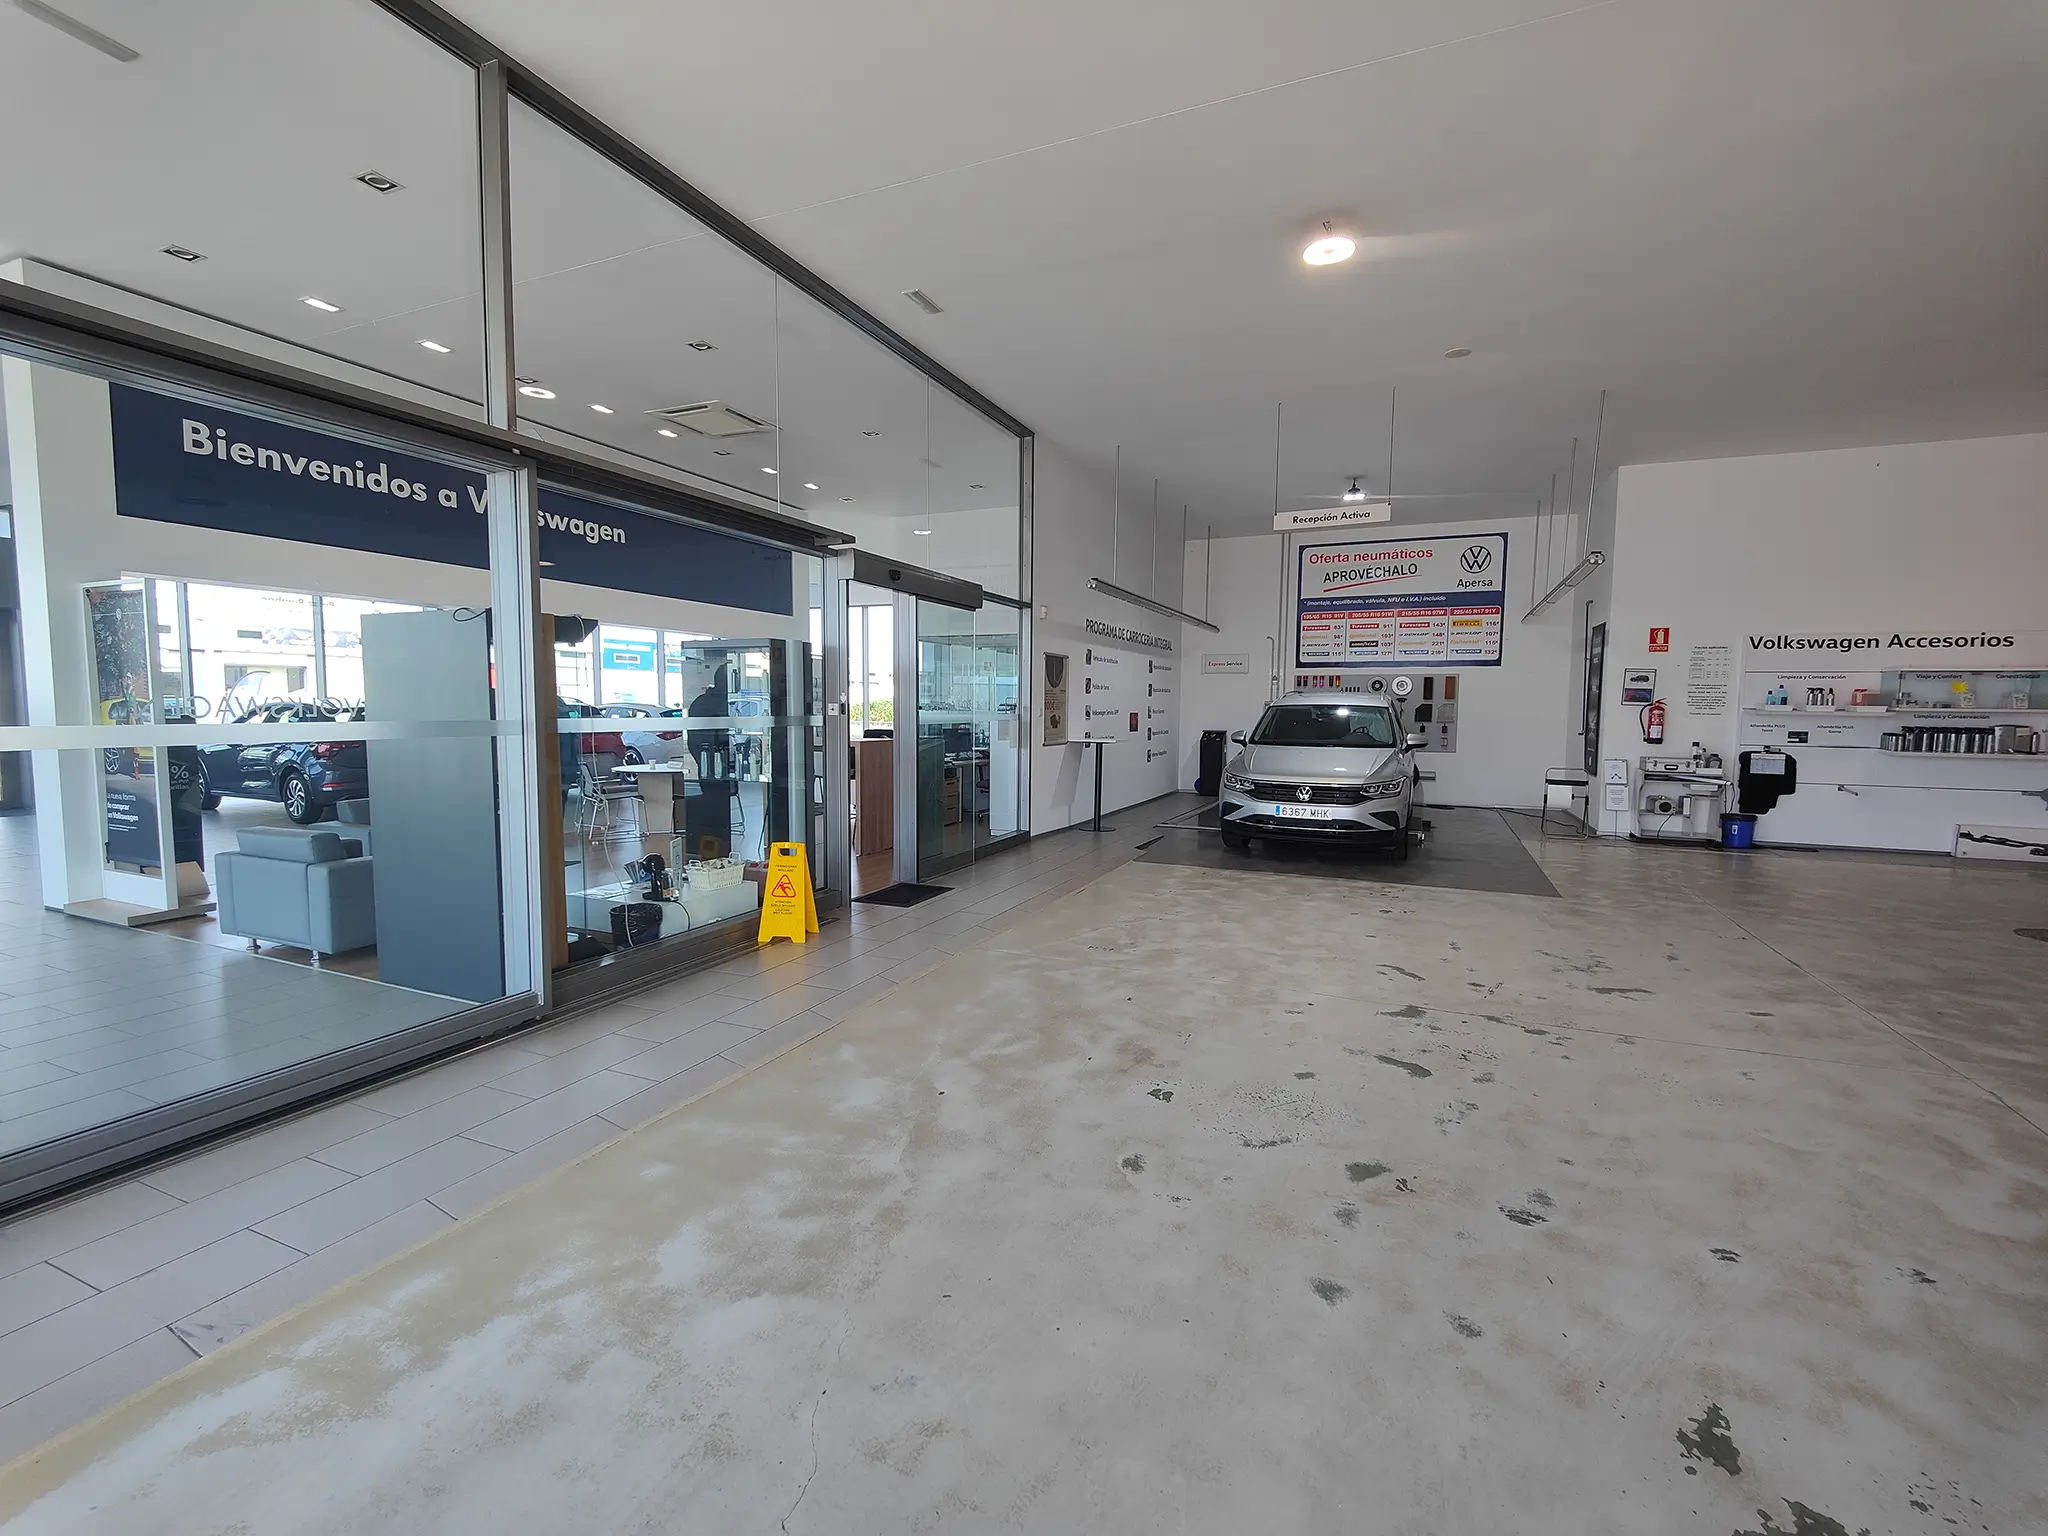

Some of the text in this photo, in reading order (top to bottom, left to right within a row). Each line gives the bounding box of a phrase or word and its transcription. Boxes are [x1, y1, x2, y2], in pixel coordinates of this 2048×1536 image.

[182, 417, 627, 545] Bienvenidos a Vswagen
[1292, 510, 1371, 525] Recepción Activa
[1309, 548, 1433, 565] Oferta neumáticos
[1323, 563, 1418, 583] APROVÉCHALO
[1456, 579, 1493, 590] Apersa
[1085, 618, 1118, 639] PROGRAMA
[1118, 627, 1126, 640] DE
[1126, 630, 1154, 648] CARROCERÍA
[1748, 632, 2015, 653] Volkswagen Accesorios
[113, 812, 139, 822] Volkswagen
[1282, 807, 1330, 819] 6367 MHK
